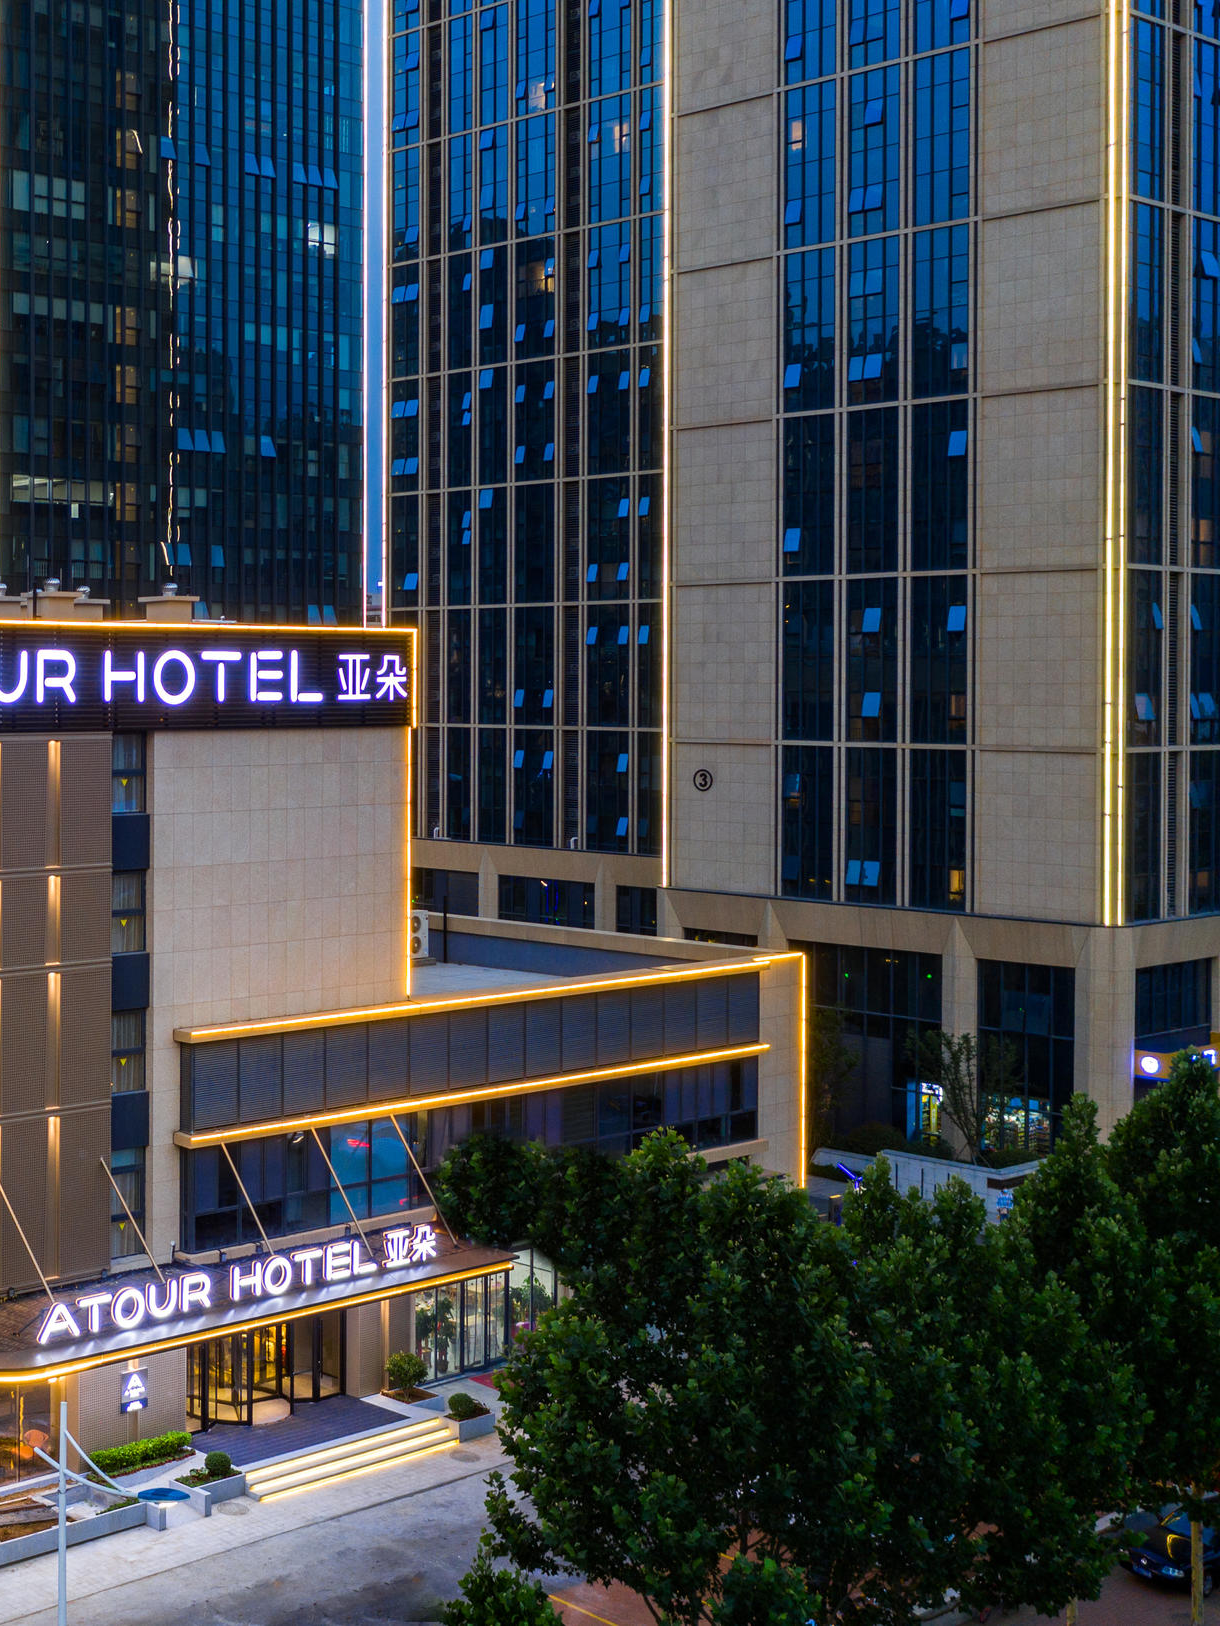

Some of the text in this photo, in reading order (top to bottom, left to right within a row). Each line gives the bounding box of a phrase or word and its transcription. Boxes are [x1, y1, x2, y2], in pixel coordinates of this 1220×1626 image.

[104, 650, 323, 705] HOTEL
[337, 653, 408, 701] 亚朵
[36, 1224, 437, 1345] ATOUR HOTEL 亚朵
